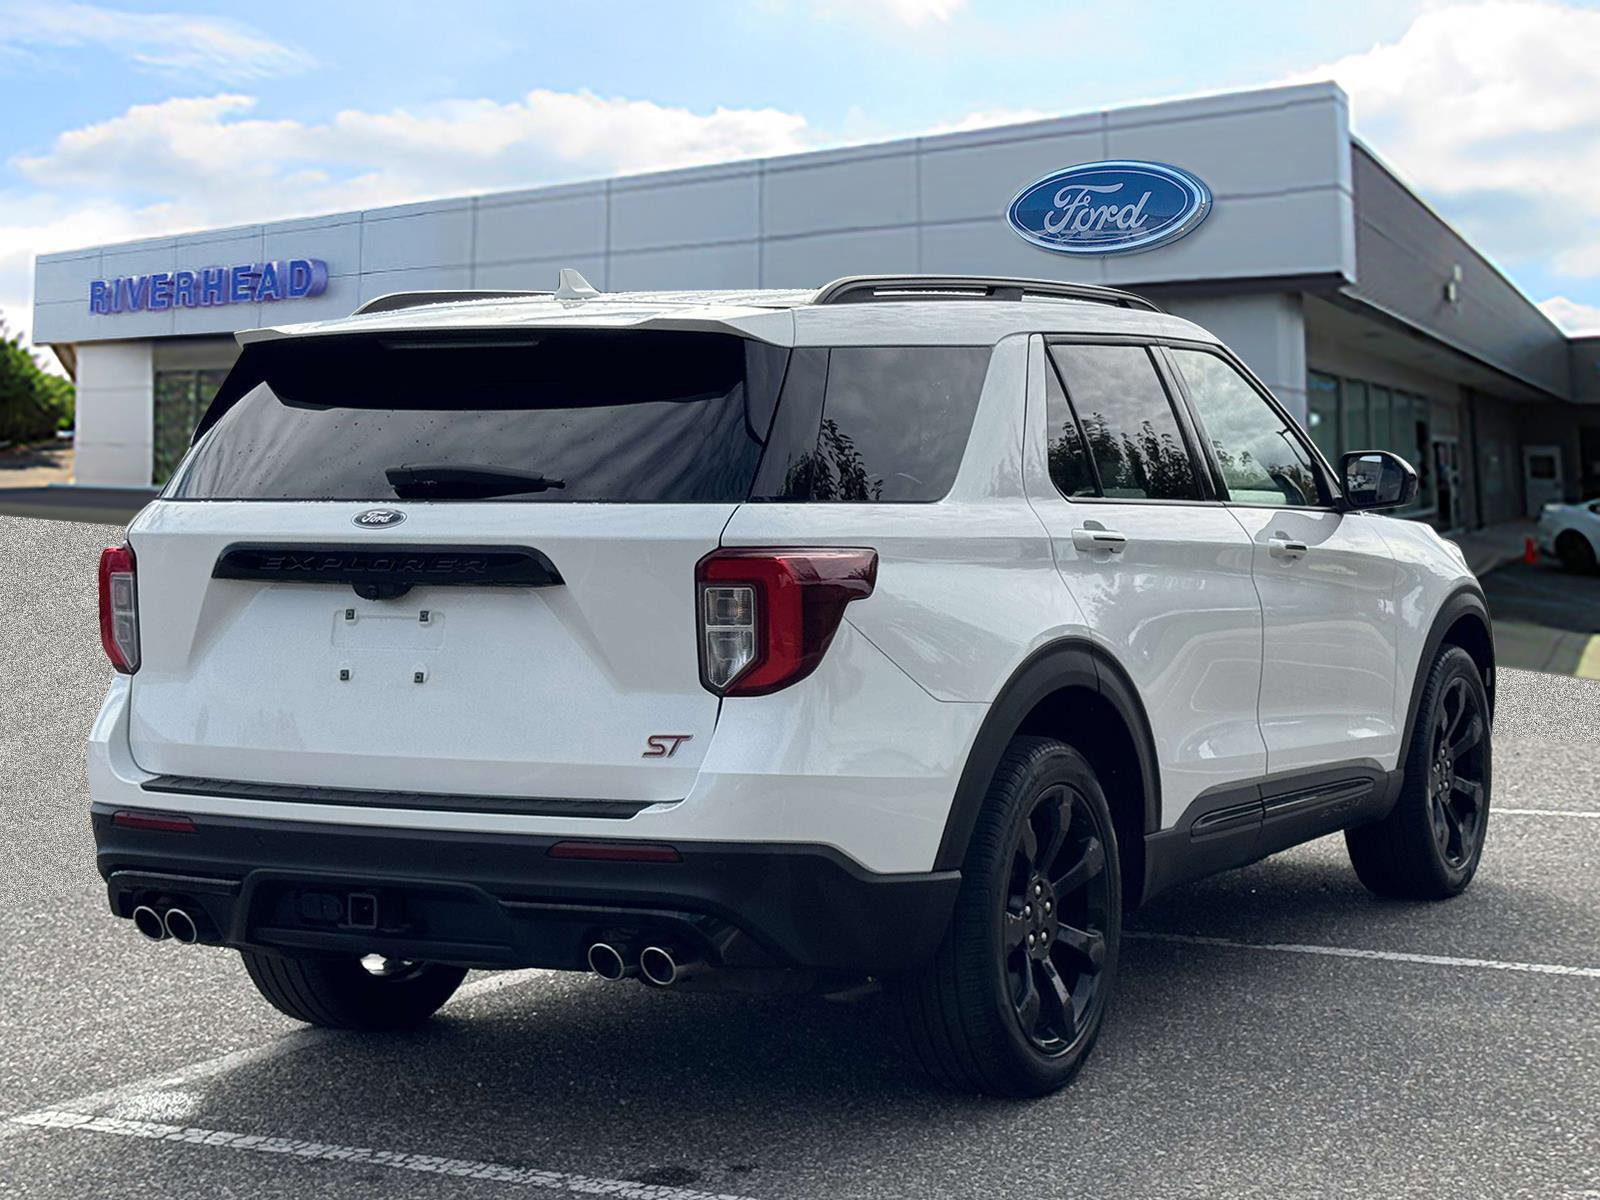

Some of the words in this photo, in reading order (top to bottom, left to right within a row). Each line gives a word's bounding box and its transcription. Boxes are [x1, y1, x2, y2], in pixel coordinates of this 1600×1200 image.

[1043, 182, 1152, 233] Ford
[89, 258, 326, 315] RIVERHEAD
[361, 510, 394, 523] Ford
[260, 556, 488, 573] EXPLORER
[641, 734, 694, 758] ST
